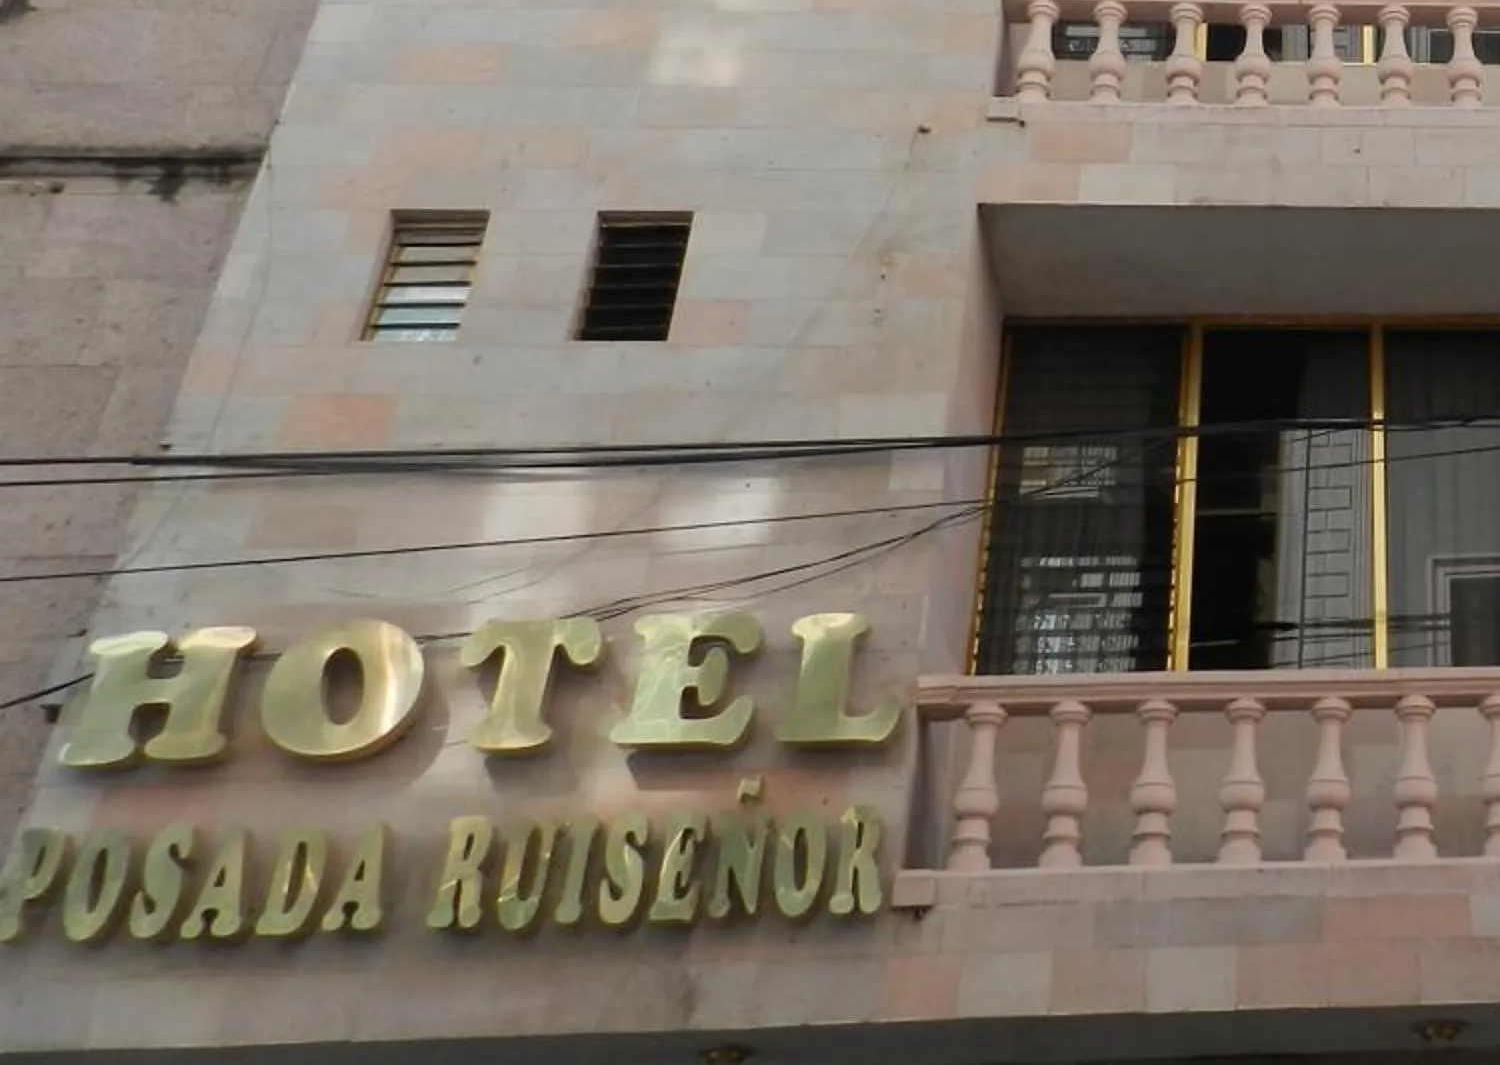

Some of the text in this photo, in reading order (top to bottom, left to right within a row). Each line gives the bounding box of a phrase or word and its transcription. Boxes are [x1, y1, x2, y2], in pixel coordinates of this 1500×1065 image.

[57, 611, 904, 771] HOTEL
[0, 774, 886, 943] POSADA RUISEÑOR
